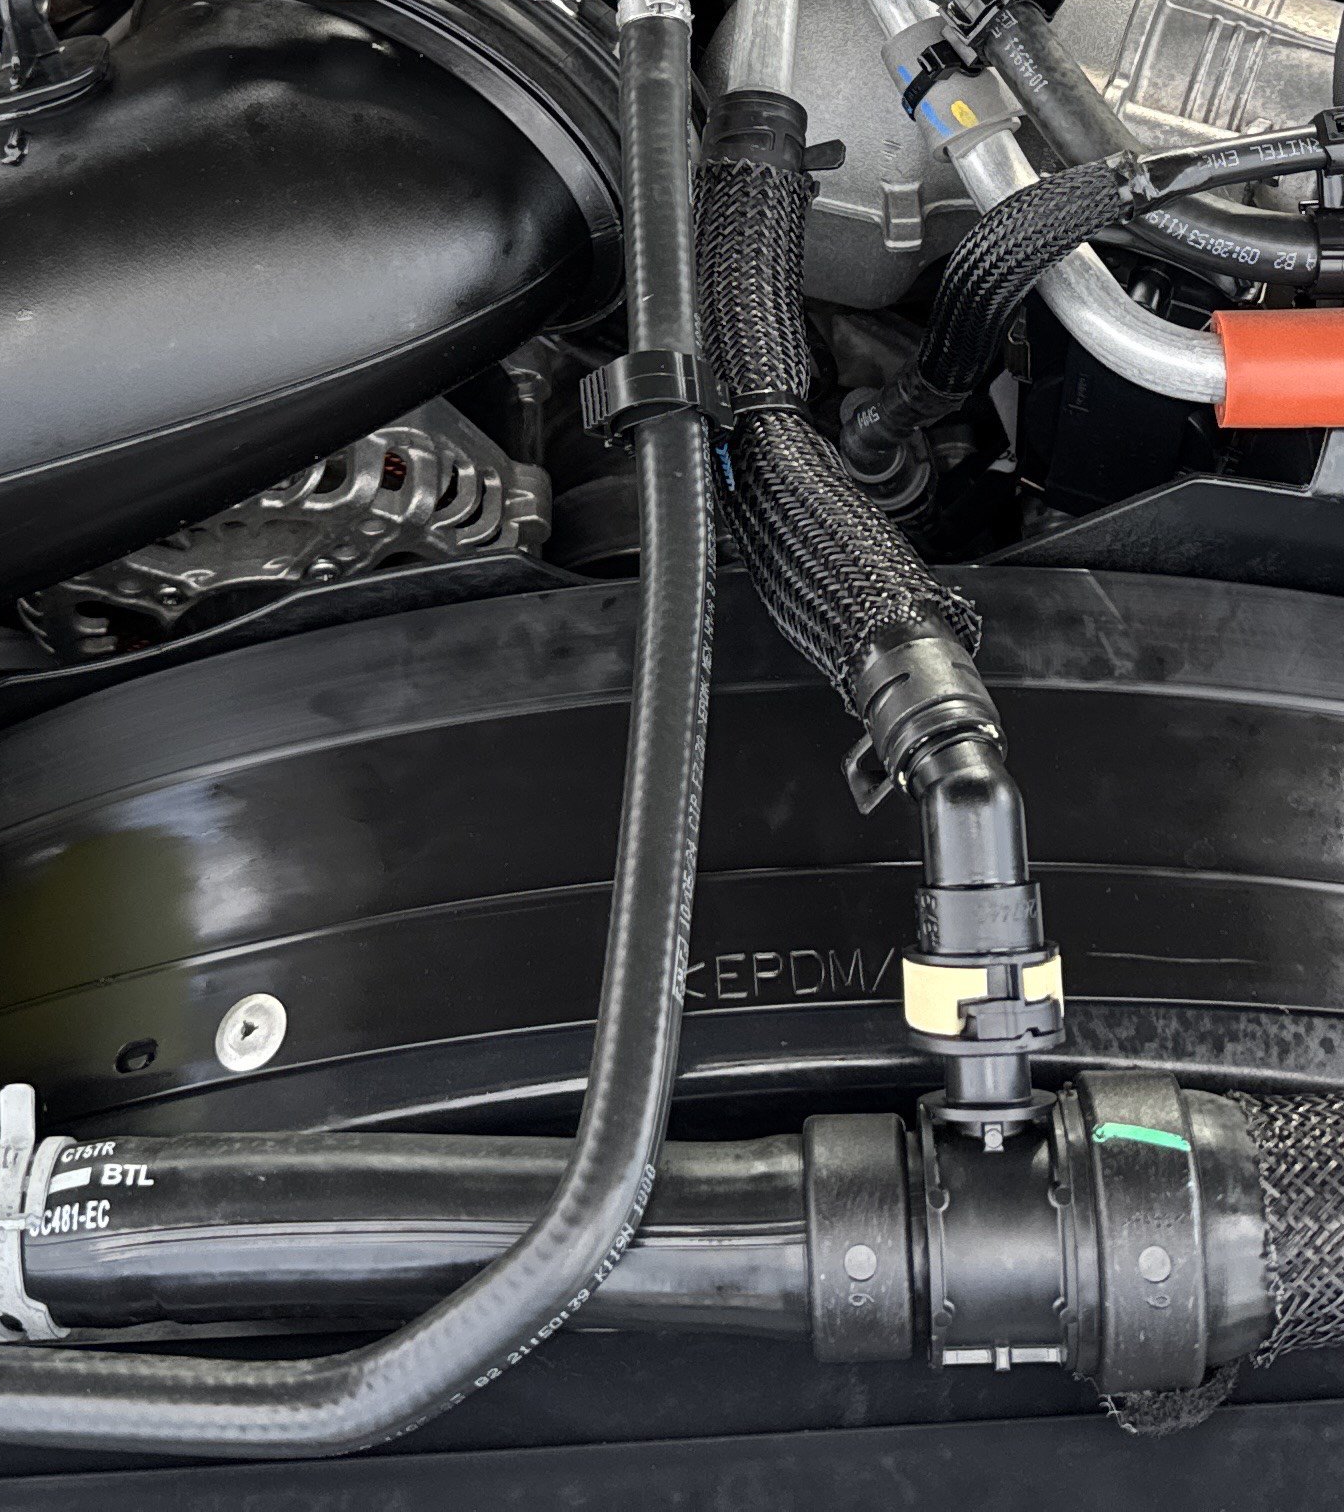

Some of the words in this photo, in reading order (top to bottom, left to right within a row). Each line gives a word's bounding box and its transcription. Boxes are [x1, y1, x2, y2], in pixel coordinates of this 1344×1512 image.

[1186, 228, 1262, 267] 09:28:53
[1273, 251, 1298, 272] B2
[59, 1140, 116, 1163] C757R
[100, 1162, 155, 1186] BTL
